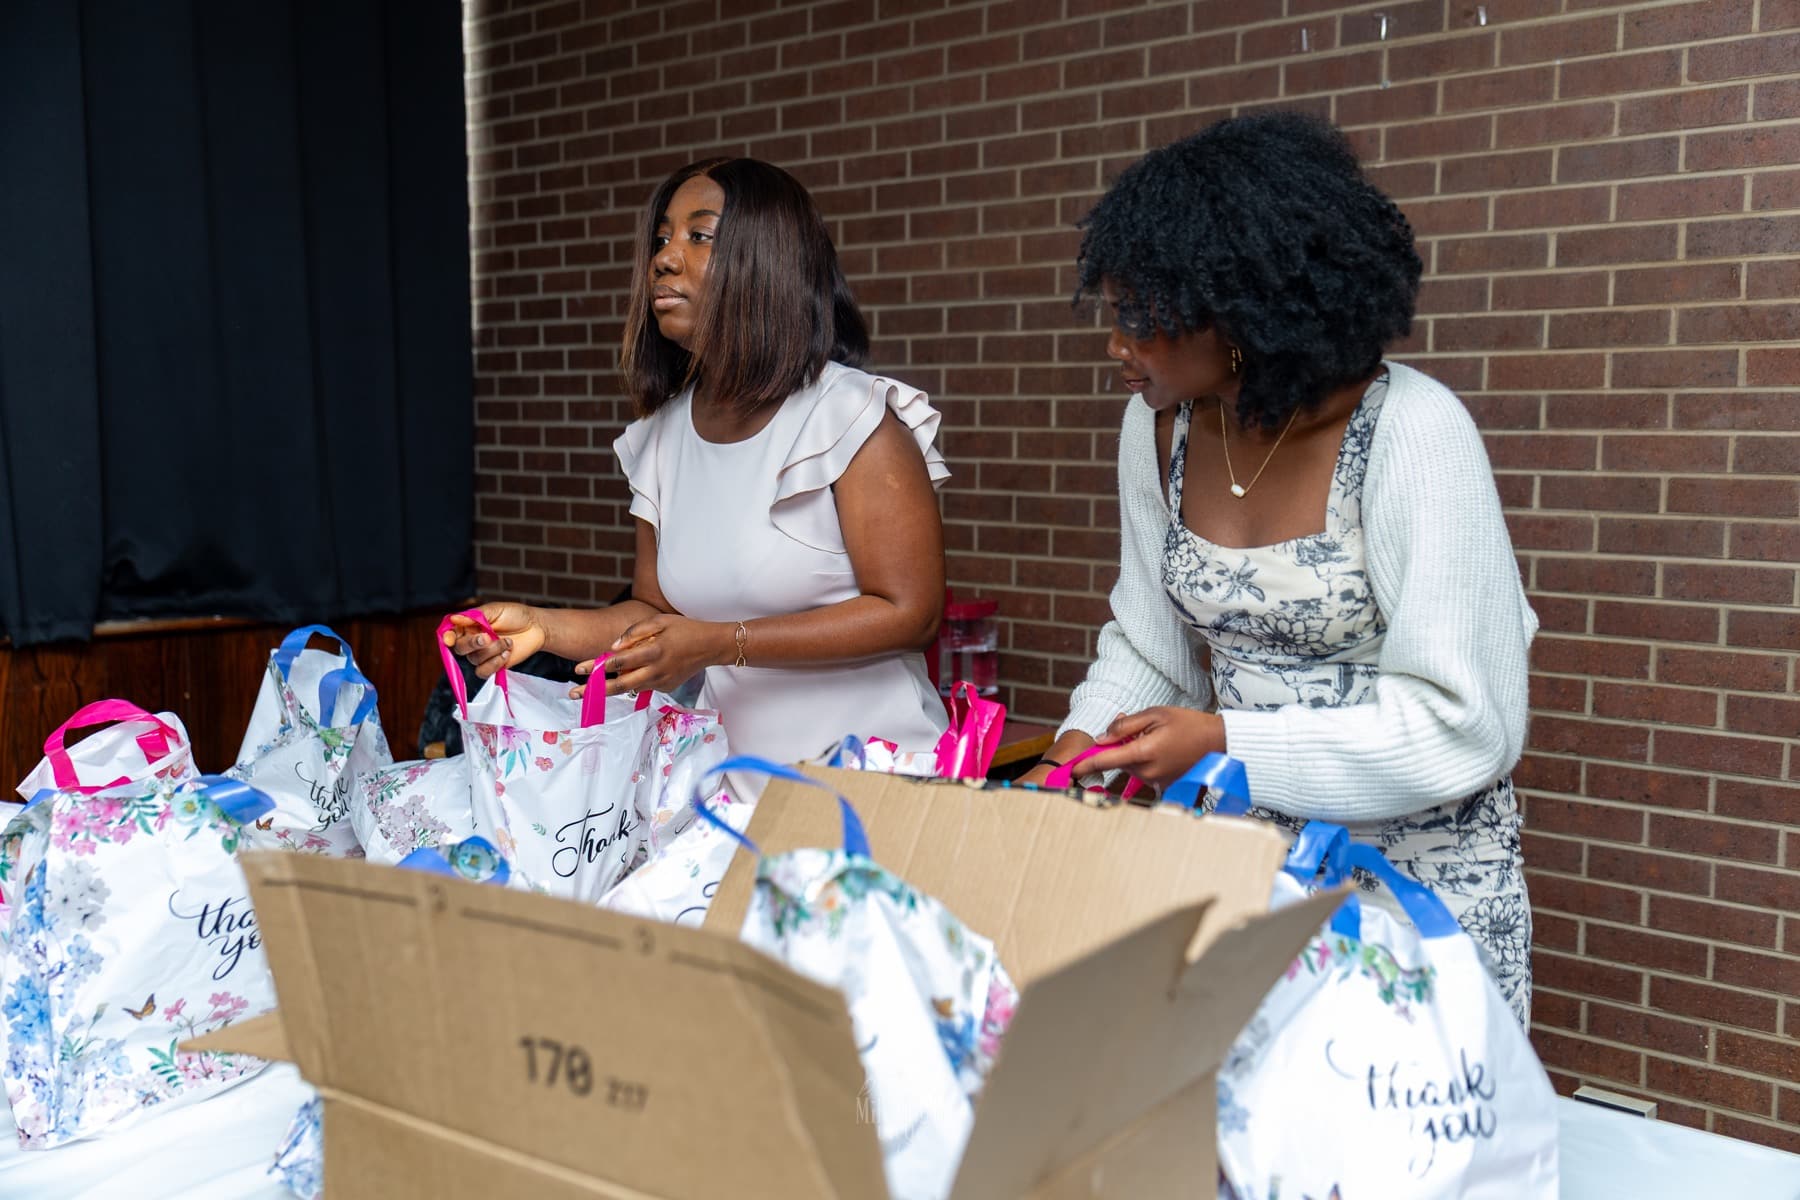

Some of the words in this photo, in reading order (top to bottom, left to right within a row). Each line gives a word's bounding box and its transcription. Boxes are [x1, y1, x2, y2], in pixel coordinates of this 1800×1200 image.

[552, 803, 640, 877] Thank
[169, 889, 257, 939] tha
[208, 928, 263, 980] yo
